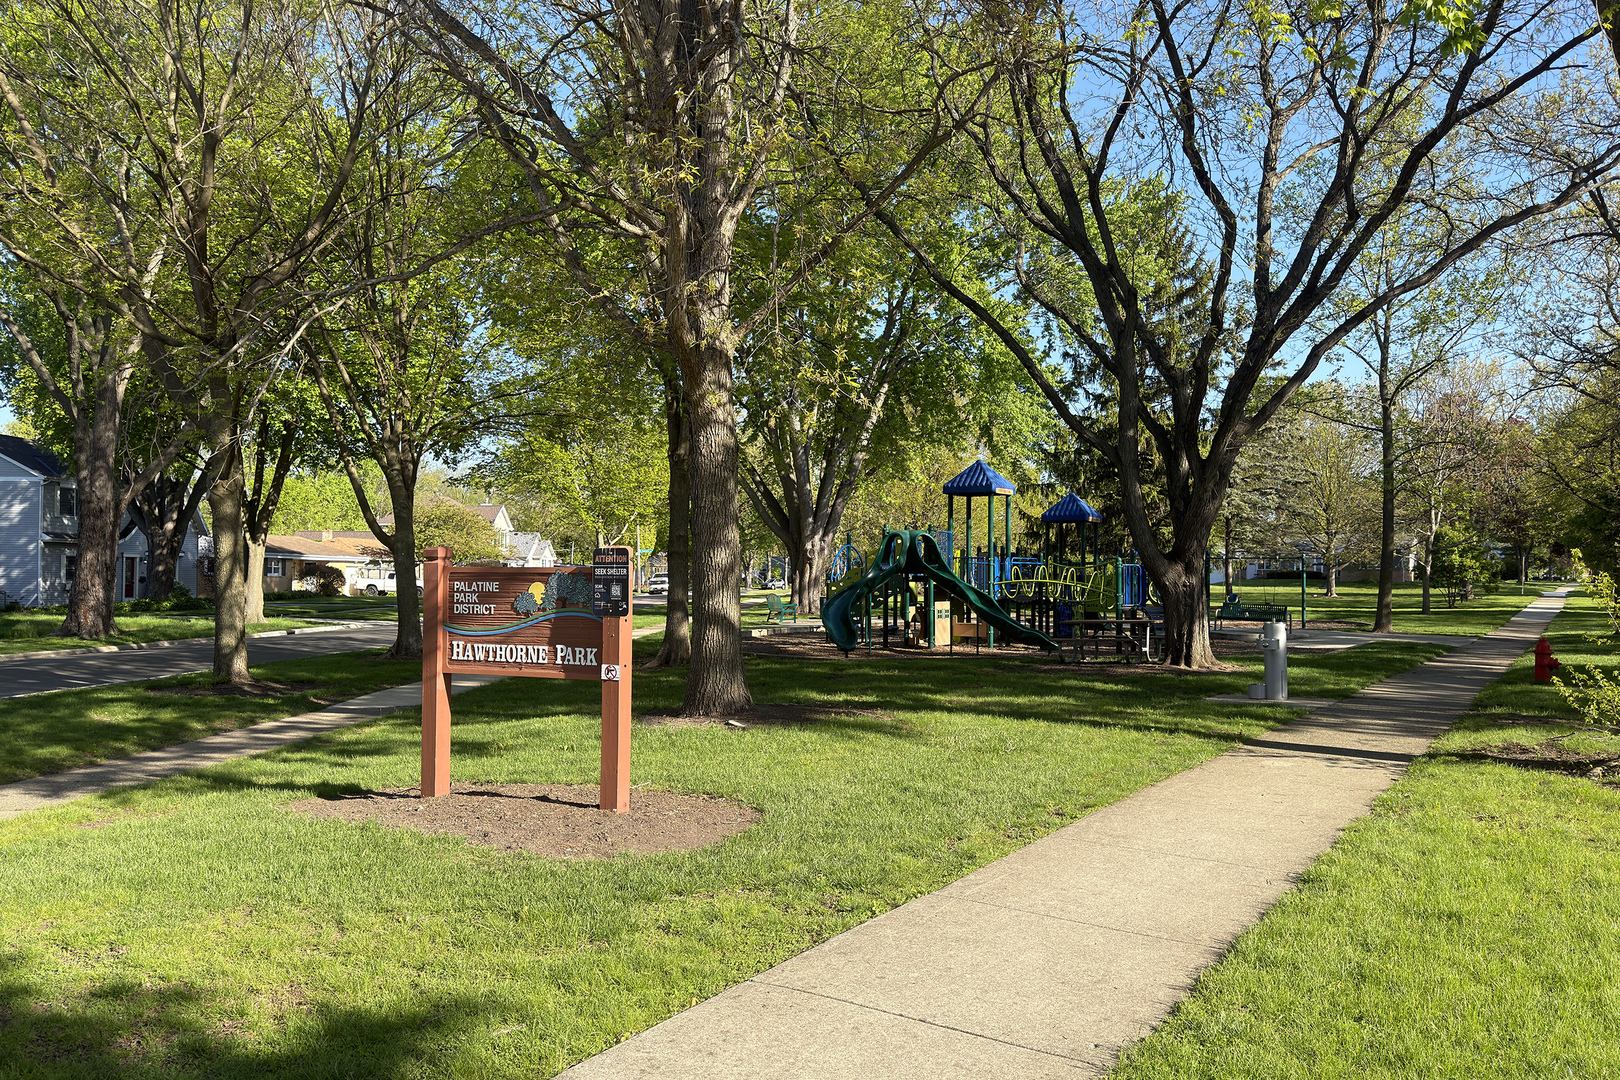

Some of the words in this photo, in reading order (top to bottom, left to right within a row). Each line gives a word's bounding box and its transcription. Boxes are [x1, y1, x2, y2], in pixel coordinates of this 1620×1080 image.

[595, 555, 627, 563] ATTENTION
[453, 581, 499, 592] PALATINE
[453, 592, 479, 603] PARK
[453, 603, 496, 615] DISTRICT
[451, 640, 548, 664] HAWTHORNE
[555, 644, 598, 666] PARK
